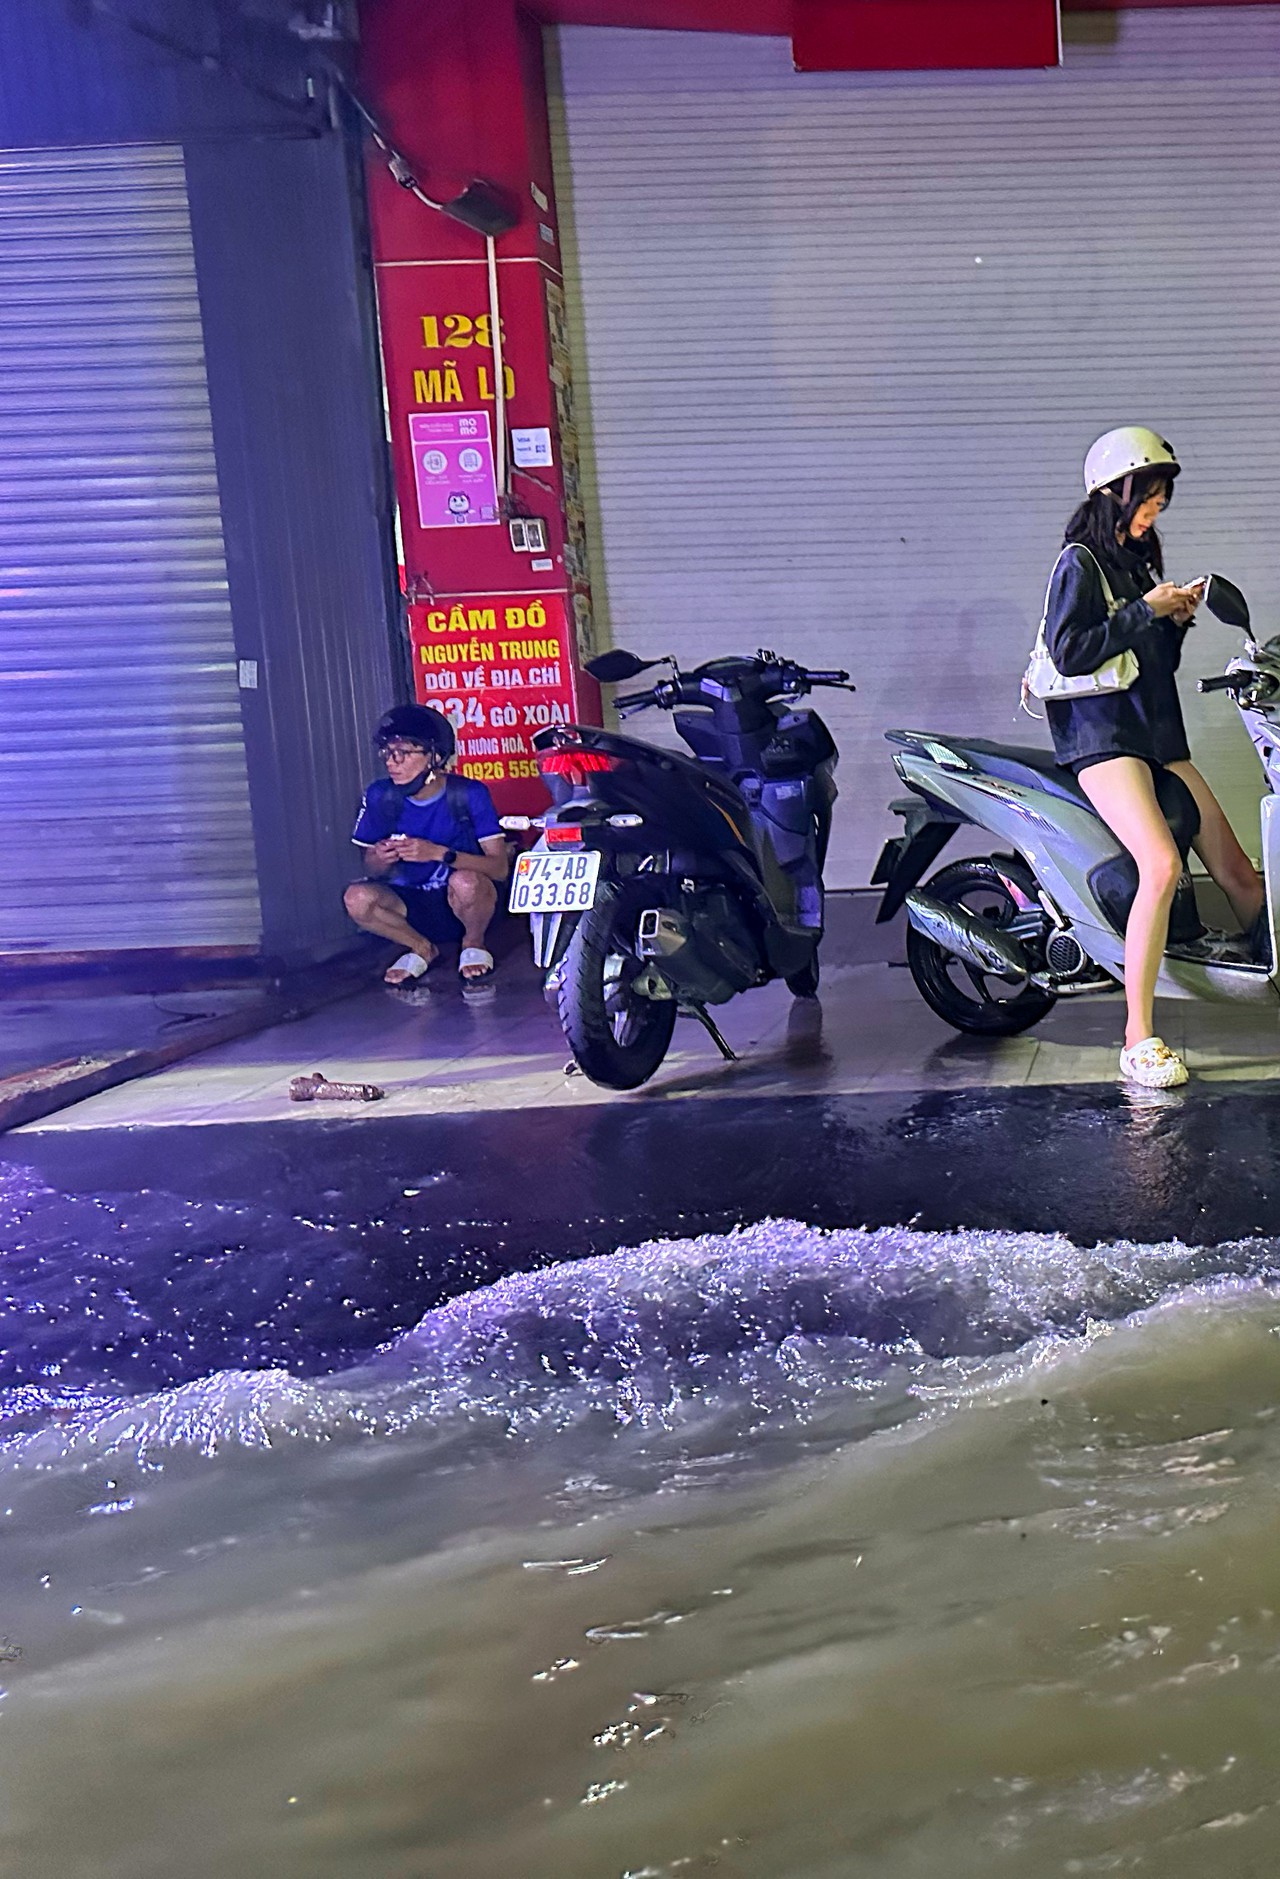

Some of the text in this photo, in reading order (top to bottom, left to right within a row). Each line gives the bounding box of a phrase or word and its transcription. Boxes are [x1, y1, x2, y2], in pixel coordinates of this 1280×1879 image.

[420, 313, 507, 349] 128
[413, 360, 464, 404] MÃ
[427, 599, 547, 633] CẦM ĐỒ
[420, 637, 561, 665] NGUYỄN TRUNG
[425, 660, 561, 690] DỜI VỀ ĐỊA CHỈ
[490, 701, 518, 728] GÒ
[523, 699, 571, 726] XOÀI
[501, 732, 529, 755] HOÀ,
[463, 761, 504, 780] 0926
[508, 759, 540, 779] 559
[529, 856, 588, 881] 74-AB
[517, 882, 592, 907] 033.68
